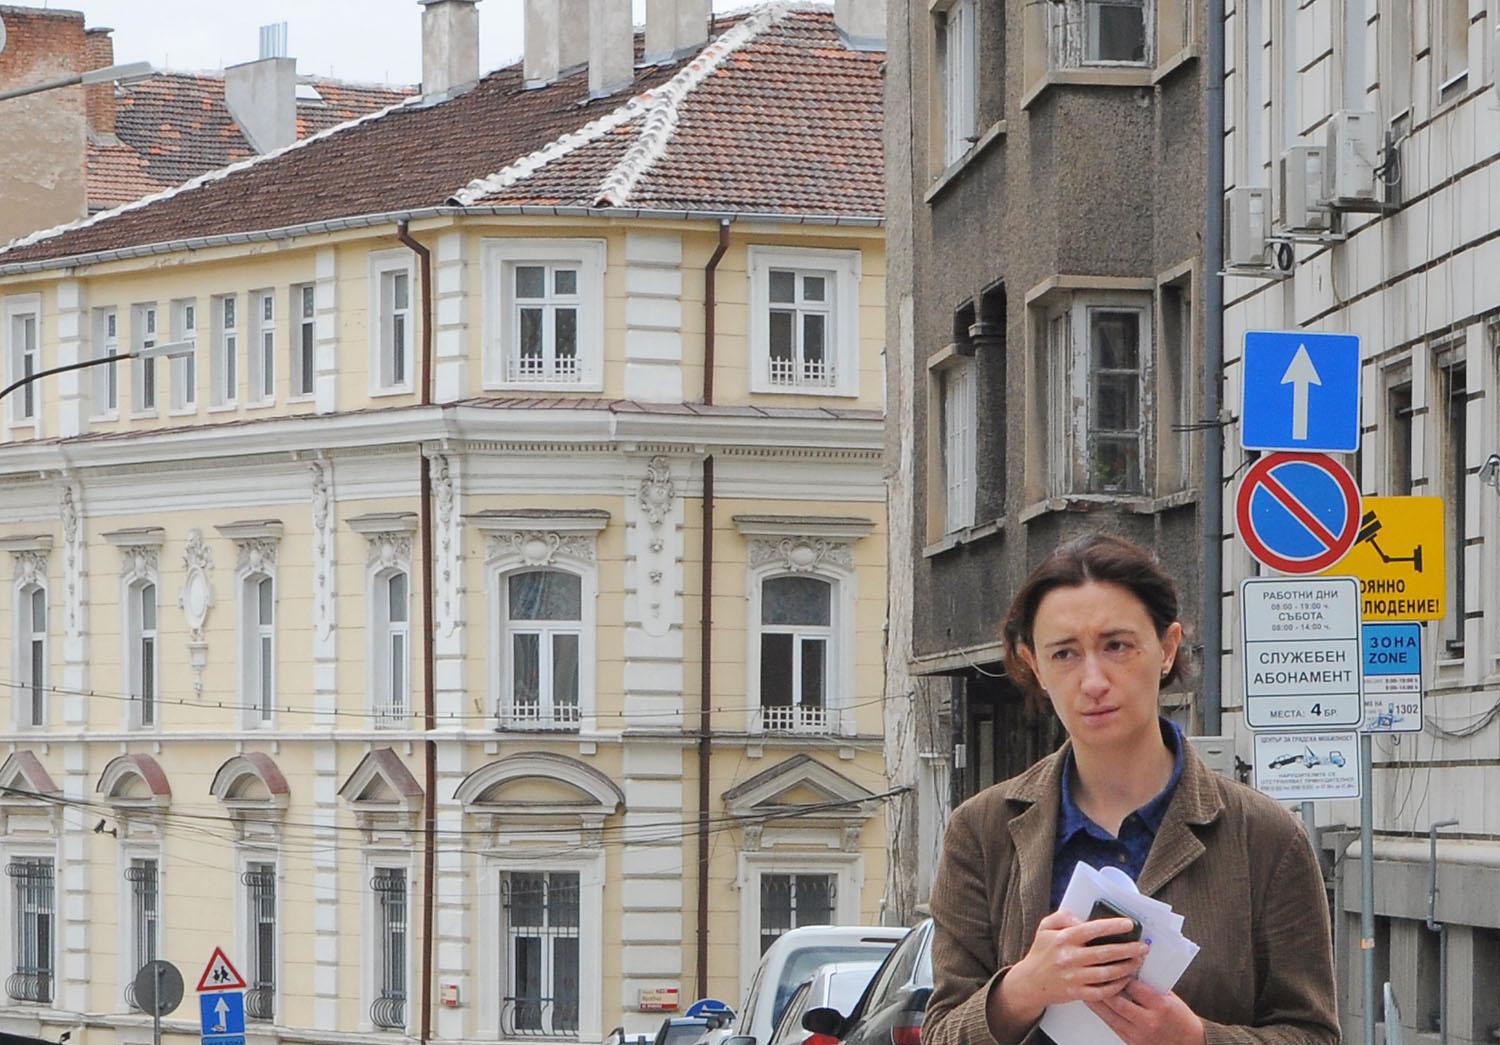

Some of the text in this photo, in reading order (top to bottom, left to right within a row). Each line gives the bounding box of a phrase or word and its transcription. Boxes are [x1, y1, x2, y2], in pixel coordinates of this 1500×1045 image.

[1263, 590, 1338, 600] РАБОТНИ ДНИ
[1362, 598, 1440, 616] ЛЮДЕНИЕ!
[1278, 612, 1323, 621] СЪБОТА
[1370, 636, 1417, 649] ЗОНА
[1260, 651, 1346, 664] СЛУЖЕБЕН
[1369, 652, 1408, 663] ZONE
[1254, 670, 1352, 684] АБОНАМЕНТ
[1310, 703, 1321, 716] 4
[1396, 704, 1418, 714] 1302
